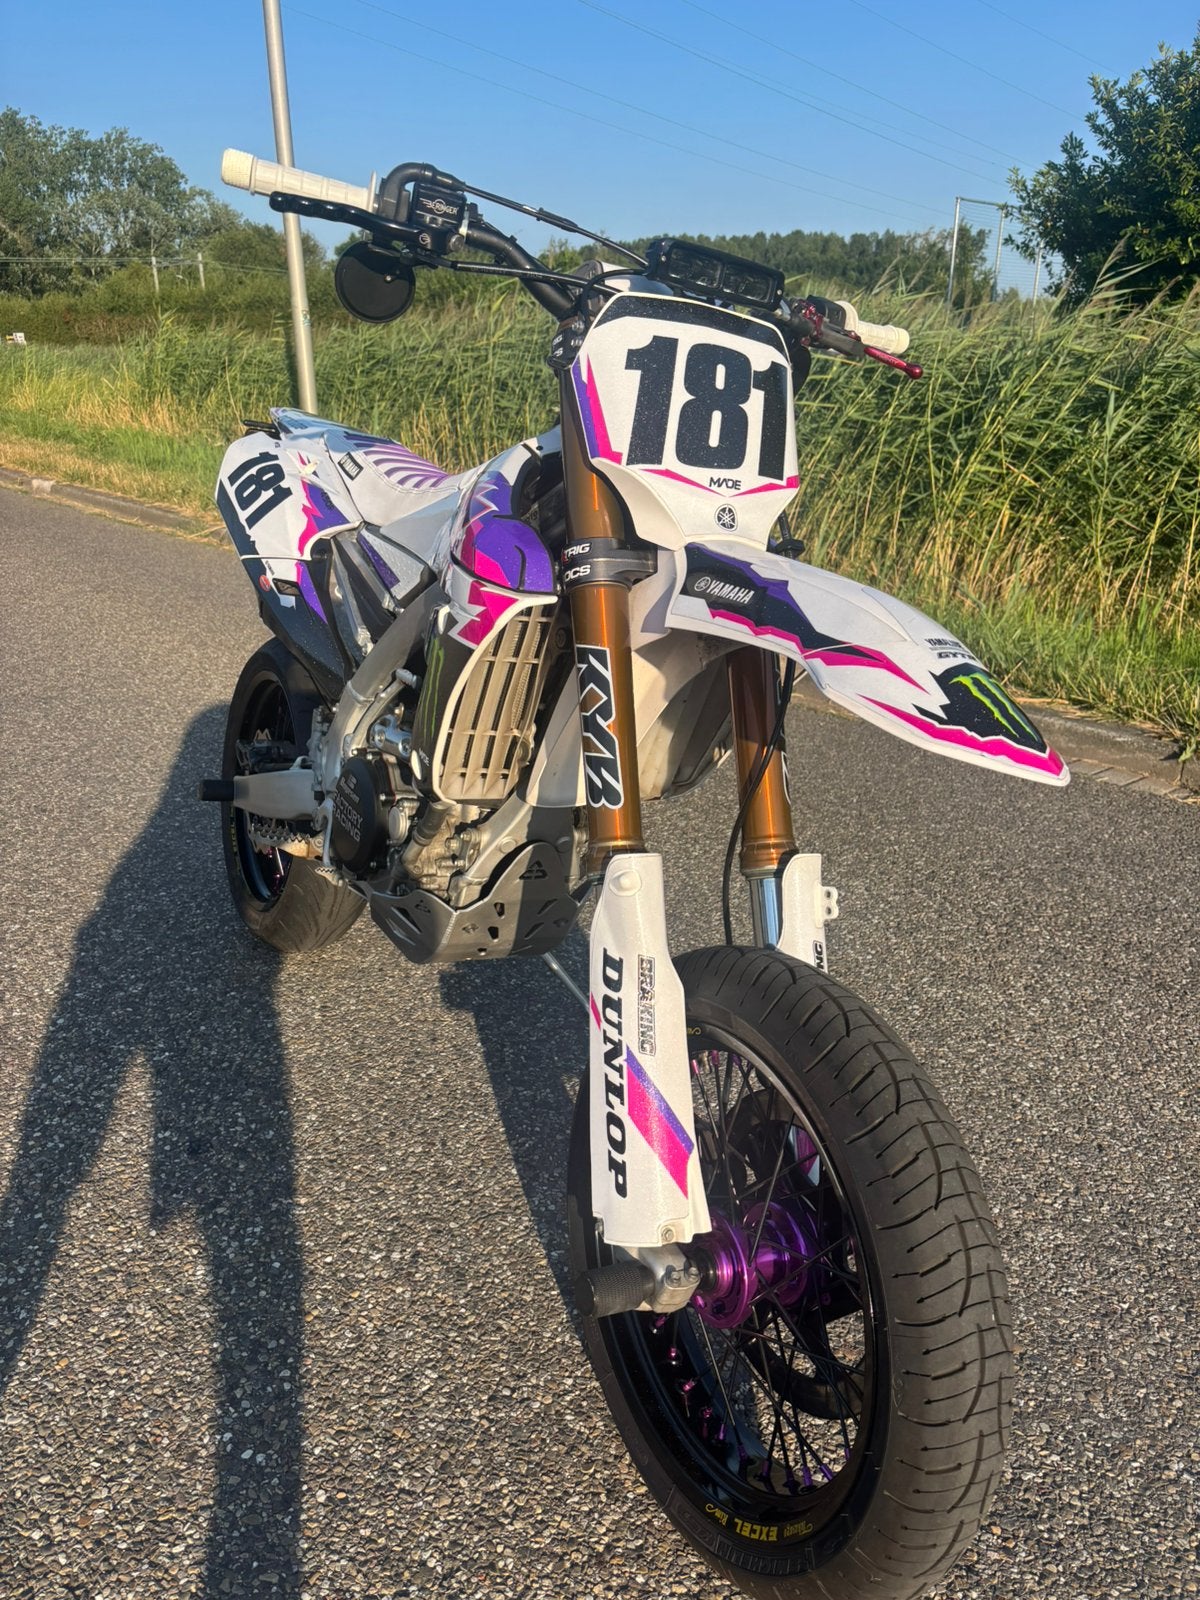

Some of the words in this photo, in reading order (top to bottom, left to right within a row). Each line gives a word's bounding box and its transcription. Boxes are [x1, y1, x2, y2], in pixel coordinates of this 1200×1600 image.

[624, 335, 789, 482] 181
[227, 451, 293, 531] 181
[709, 476, 742, 491] MADE
[564, 564, 591, 582] OCS
[706, 579, 755, 604] YAMAHA
[575, 644, 625, 809] KYB
[638, 954, 656, 1056] BRAKING
[602, 946, 628, 1199] DUNLOP
[734, 1518, 779, 1541] EXCEL
